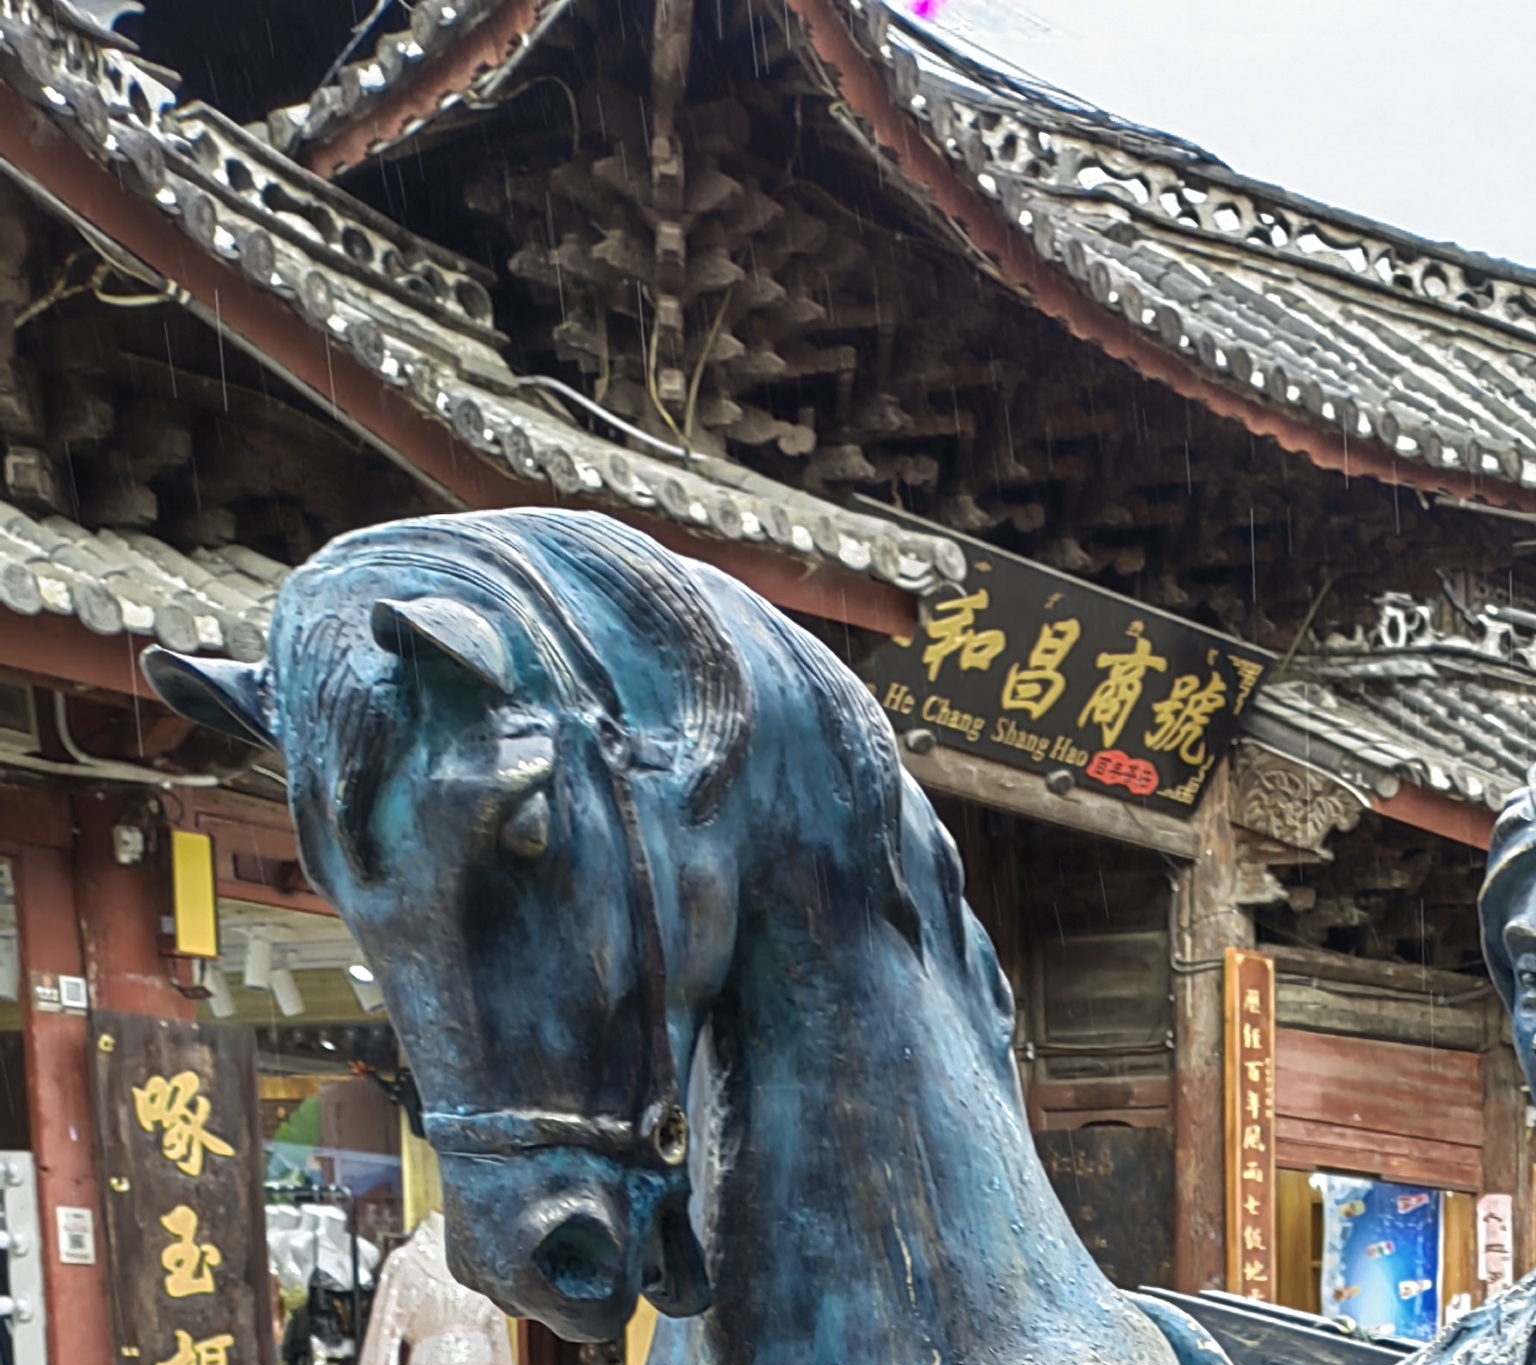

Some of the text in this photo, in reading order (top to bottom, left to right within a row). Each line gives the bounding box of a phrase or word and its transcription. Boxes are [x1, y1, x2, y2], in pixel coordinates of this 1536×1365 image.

[883, 682, 1089, 767] He Chang Shang Hao
[892, 588, 1227, 765] 和昌商號
